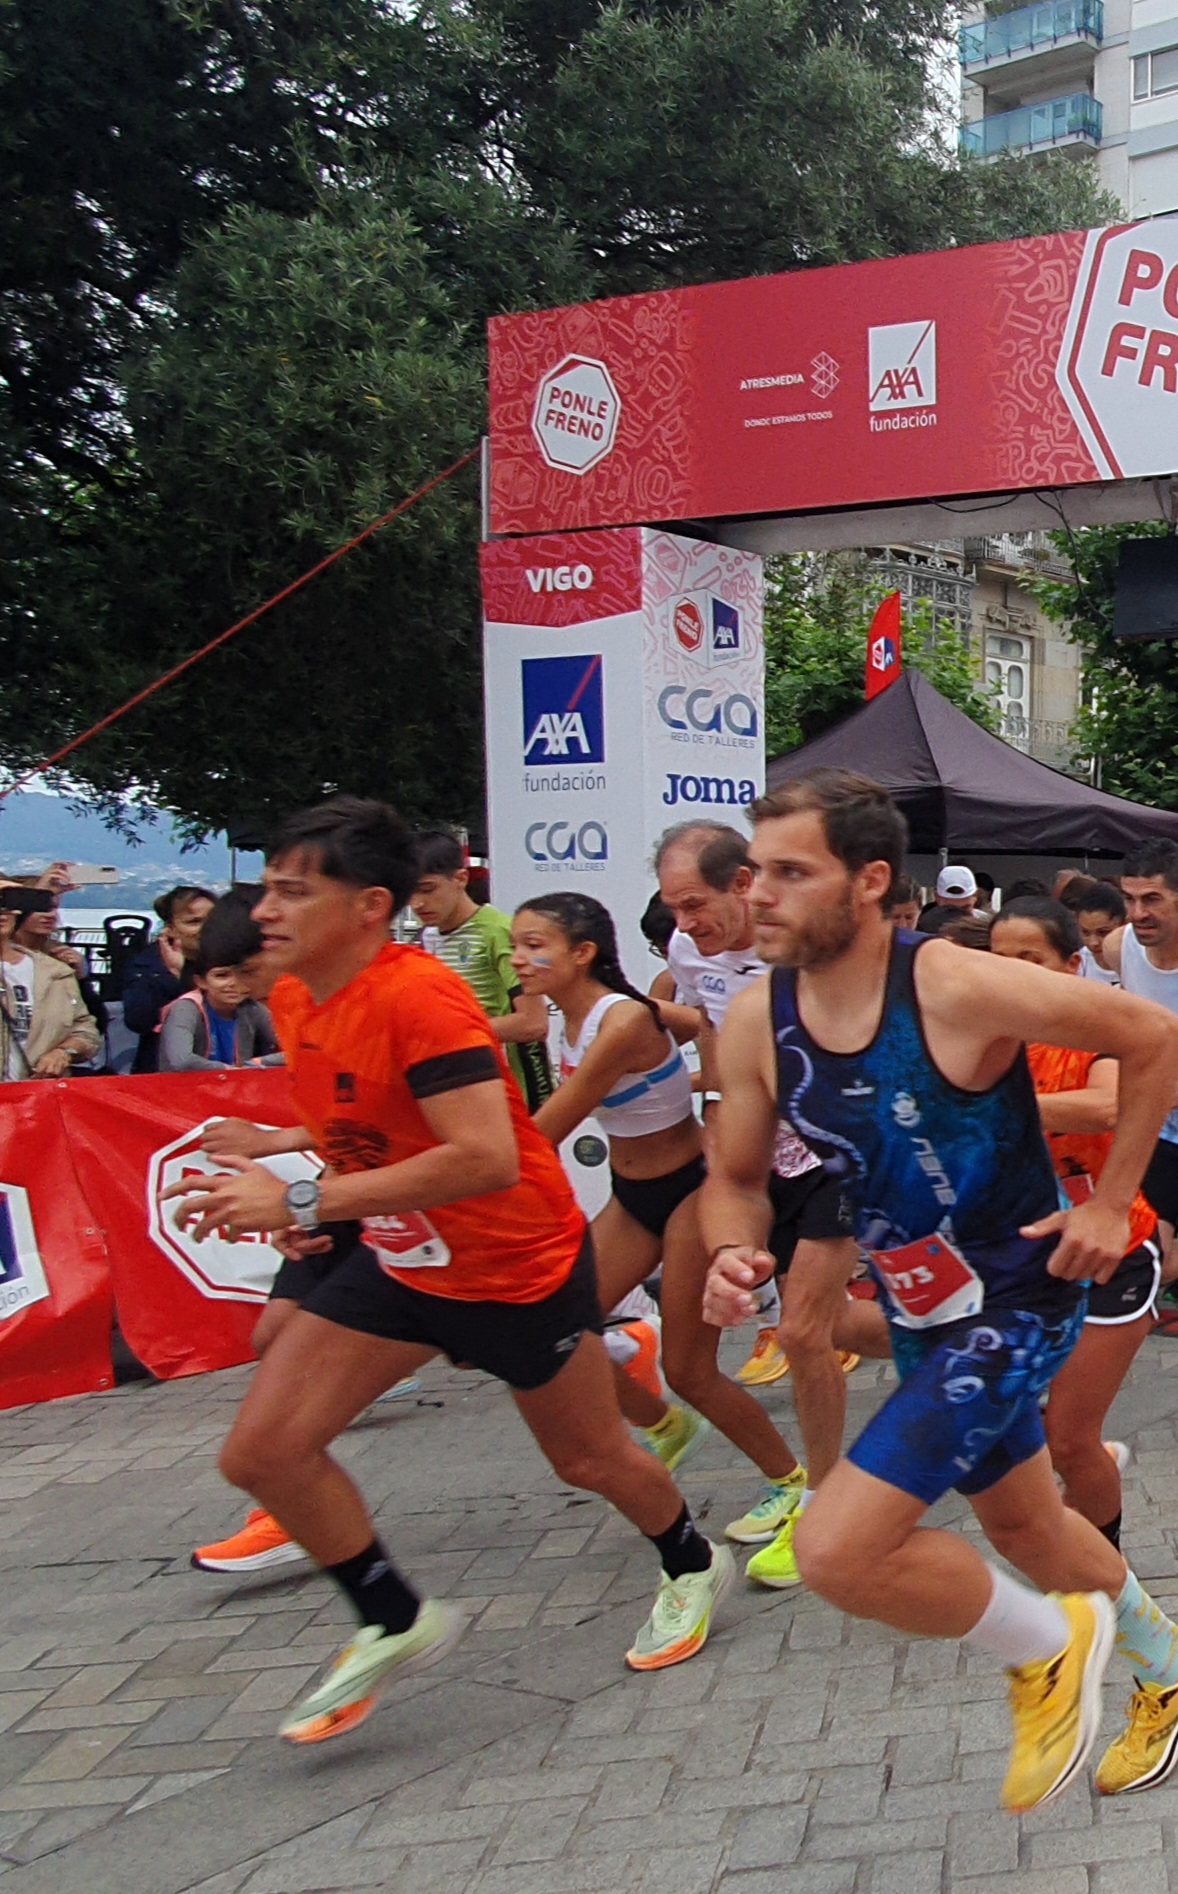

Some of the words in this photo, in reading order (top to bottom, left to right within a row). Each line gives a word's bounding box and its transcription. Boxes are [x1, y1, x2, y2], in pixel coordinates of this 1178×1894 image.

[739, 373, 805, 391] ATRESMEDIA
[869, 366, 924, 402] AXA
[548, 387, 608, 421] PONLE
[543, 409, 604, 441] FRENO
[870, 409, 937, 433] fundación
[525, 564, 594, 592] VIGO
[523, 712, 590, 757] AXA
[670, 731, 689, 743] RED
[692, 733, 705, 745] DE
[706, 735, 755, 749] TALLERES
[524, 770, 606, 793] fundación
[563, 862, 606, 872] TALLERES
